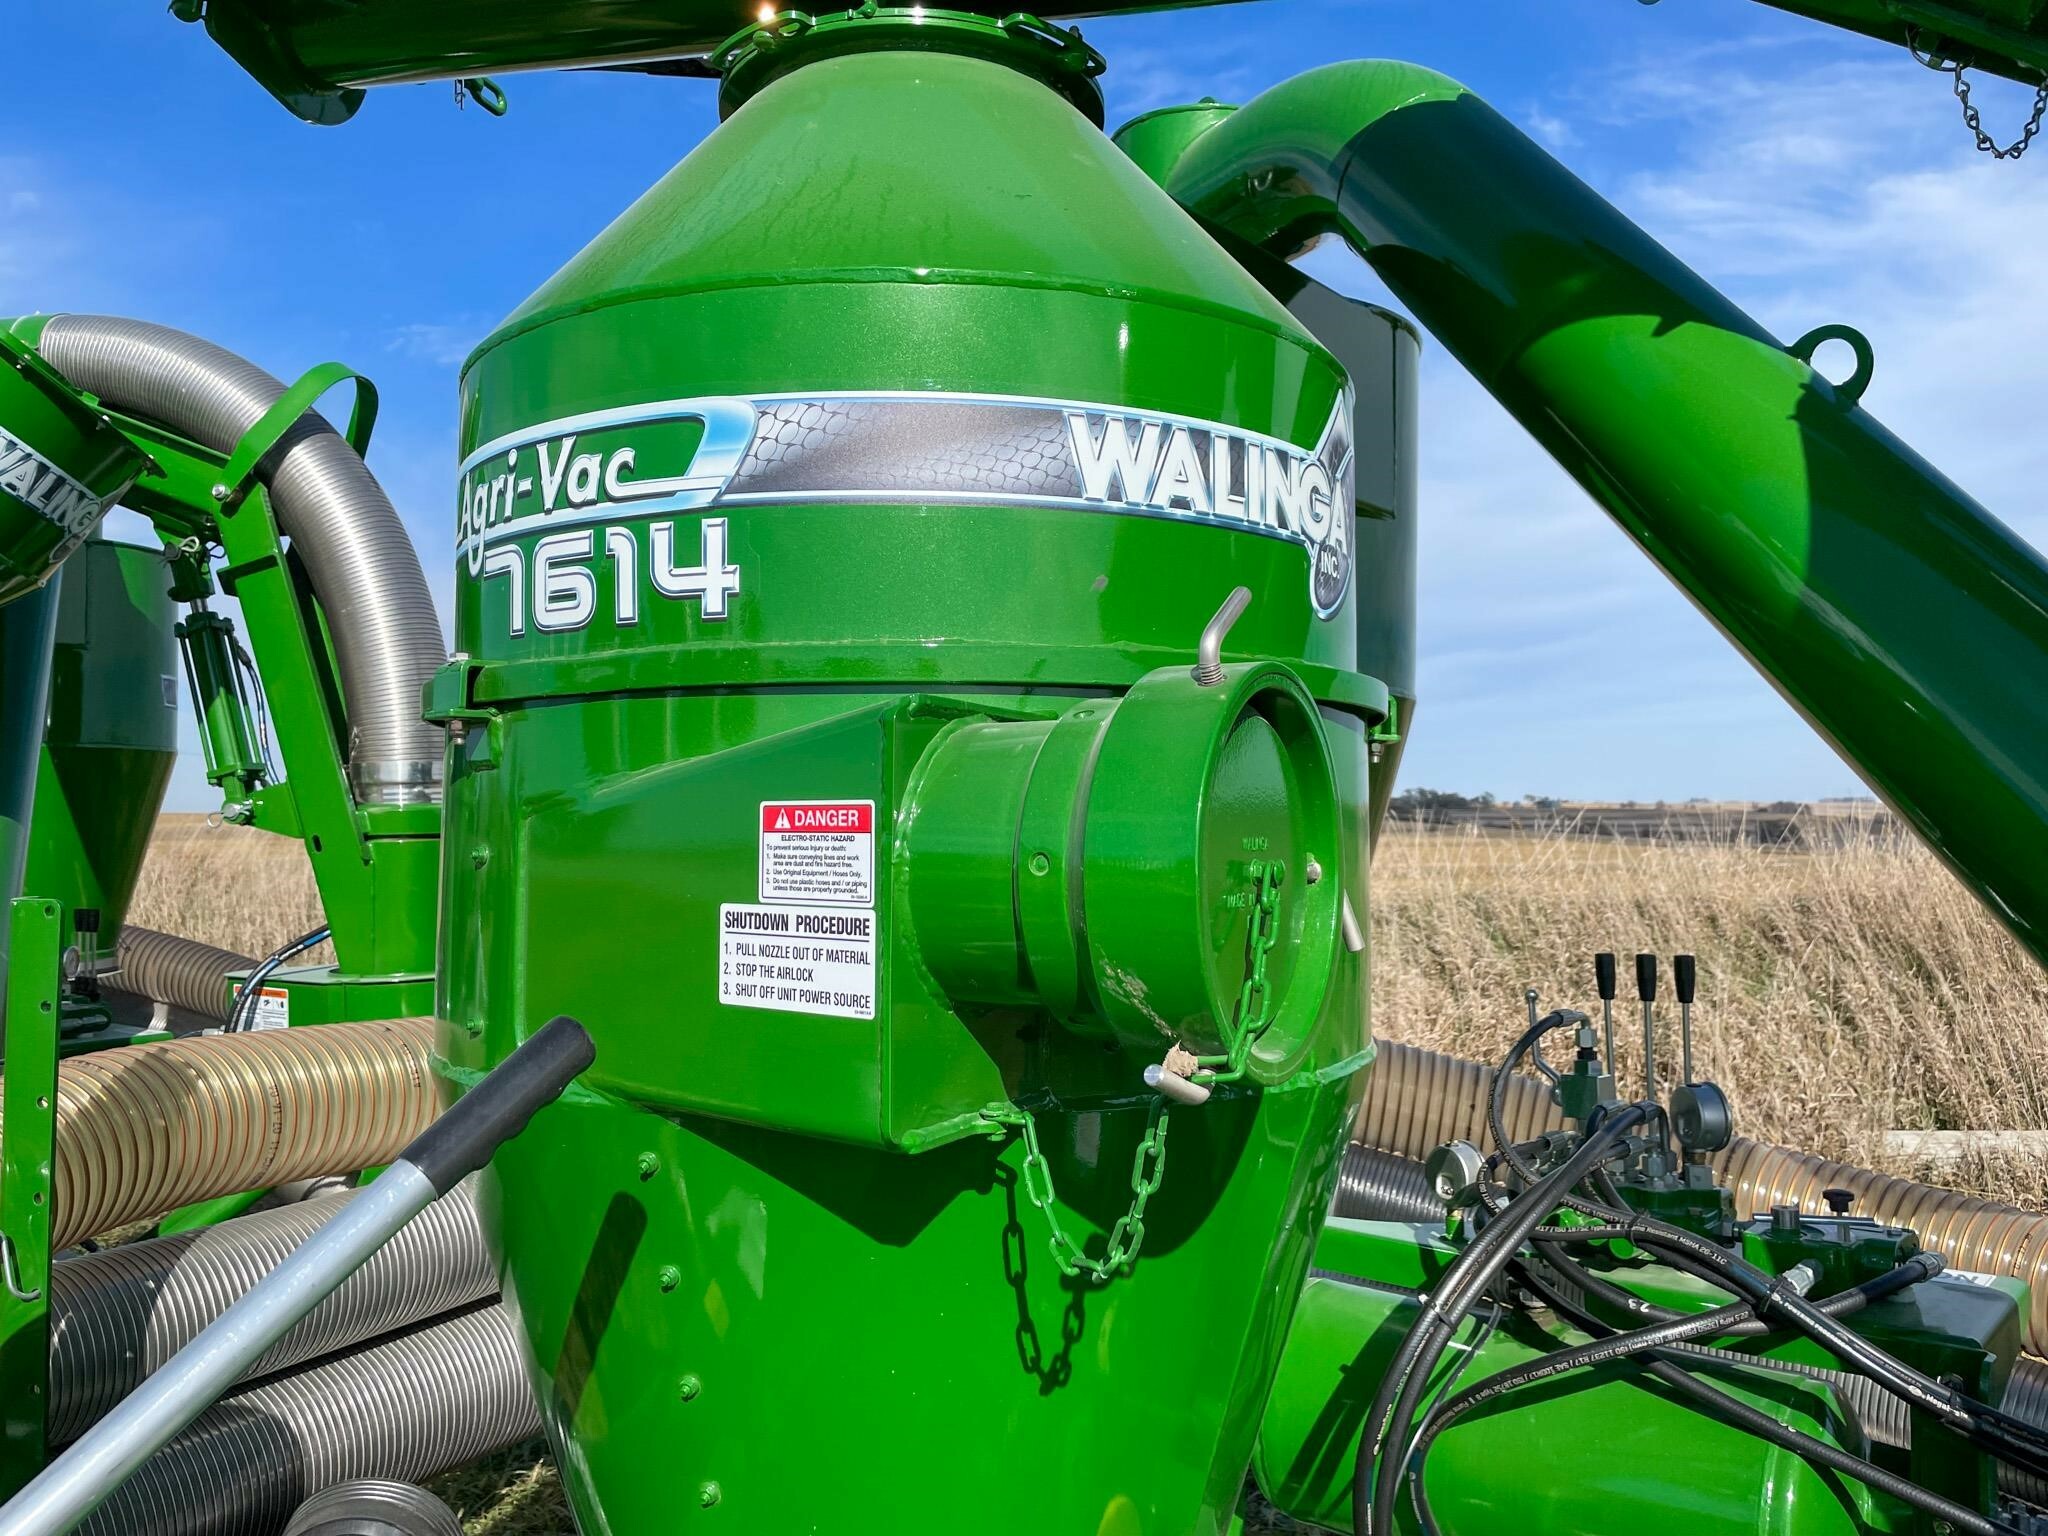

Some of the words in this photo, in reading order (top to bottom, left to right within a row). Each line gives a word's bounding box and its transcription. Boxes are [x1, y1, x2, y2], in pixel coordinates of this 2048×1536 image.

[1063, 409, 1349, 556] WALINGA
[457, 434, 727, 578] Agri-Vac
[1320, 550, 1340, 579] INC.
[484, 517, 740, 638] 7614
[794, 809, 859, 827] DANGER
[781, 834, 830, 842] ELECTRO-STATIC
[799, 854, 822, 862] conveying
[783, 869, 801, 877] Original
[802, 870, 828, 878] Equipment
[812, 886, 832, 894] properly
[725, 910, 789, 932] SHUTDOWN
[796, 914, 870, 936] PROCEDURE
[724, 942, 732, 955] 1.
[736, 943, 756, 956] PULL
[759, 945, 790, 959] NOZZLE
[792, 947, 810, 960] OUT
[812, 948, 824, 961] OF
[826, 950, 870, 965] MATERIAL
[724, 963, 731, 976] 2.
[736, 964, 757, 977] STOP
[759, 965, 774, 978] THE
[776, 966, 814, 982] AIRLOCK
[724, 983, 731, 995] 3.
[736, 983, 757, 997] SHUT
[760, 985, 776, 998] OFF
[777, 986, 796, 1000] UNIT
[800, 988, 831, 1005] POWER
[833, 992, 870, 1009] SOURCE
